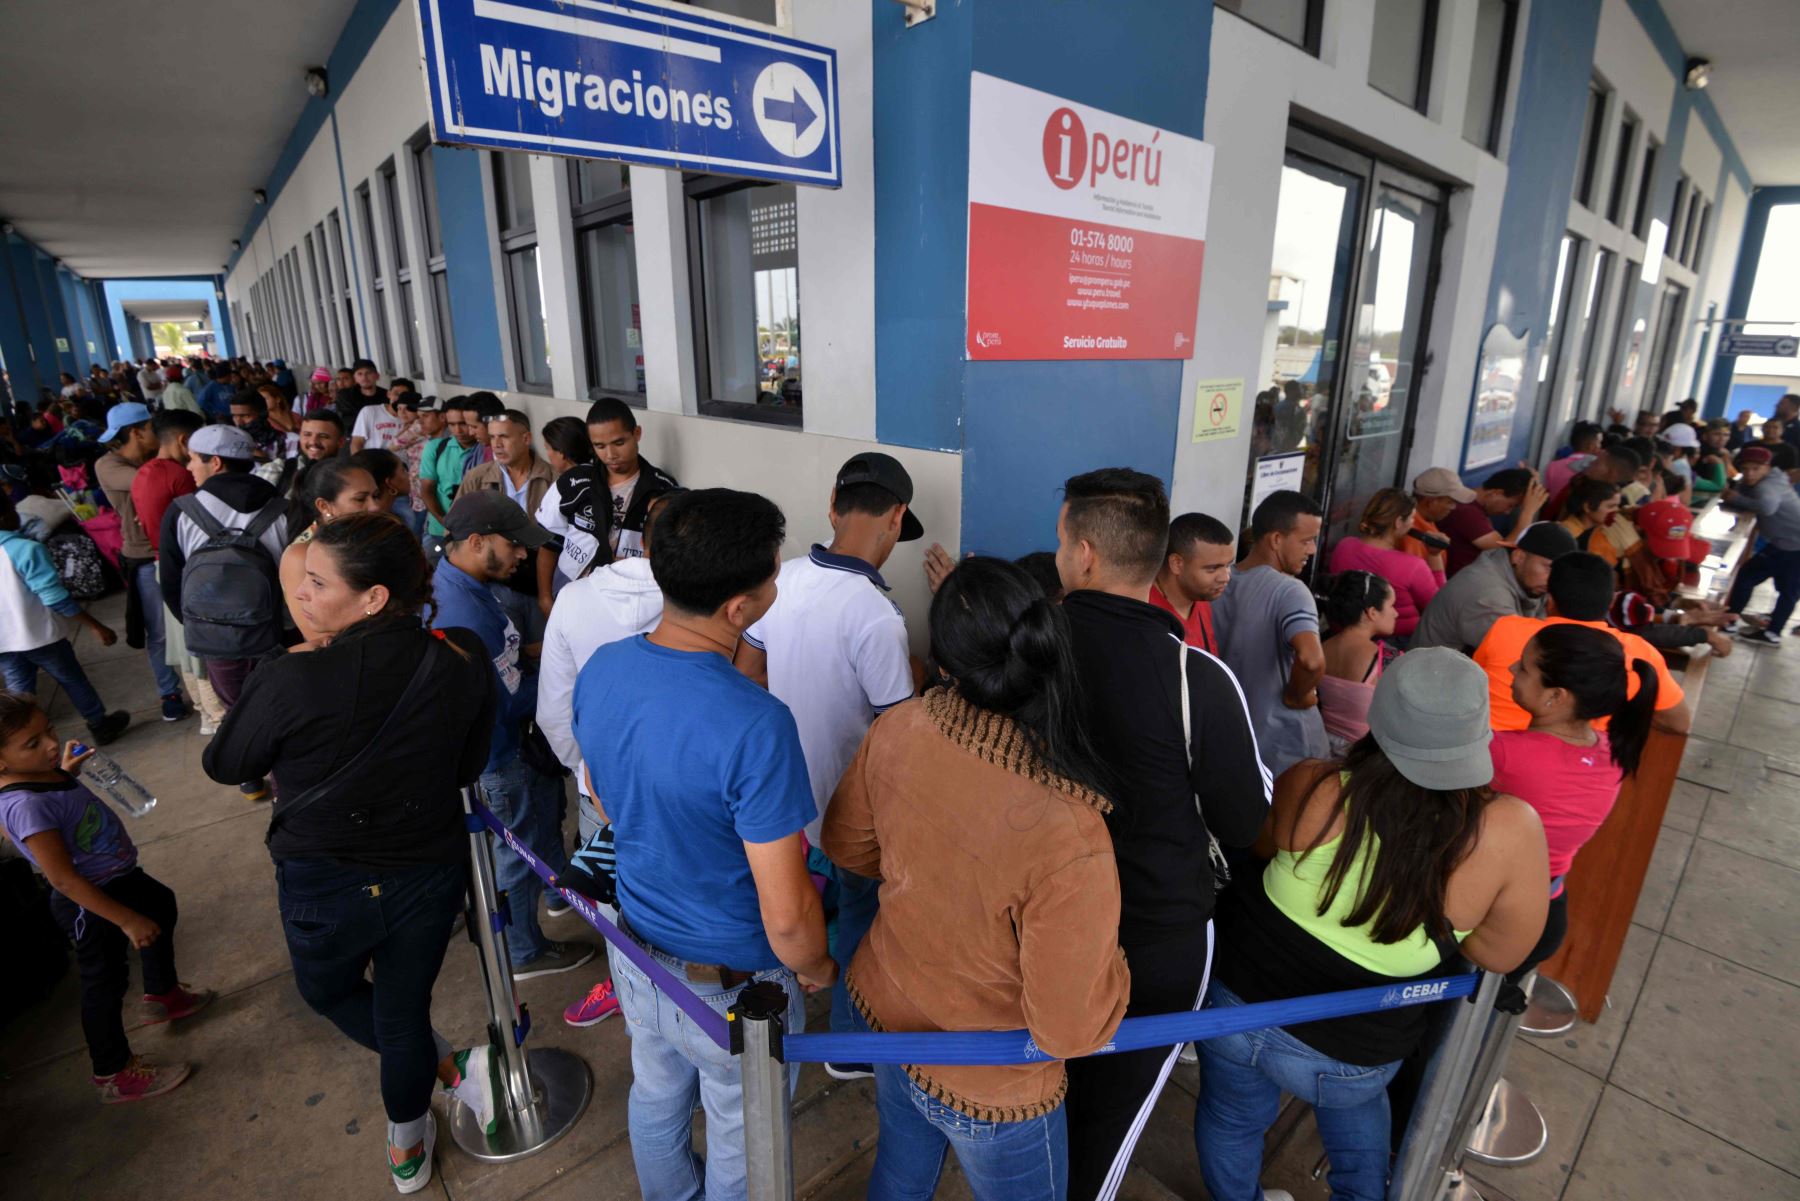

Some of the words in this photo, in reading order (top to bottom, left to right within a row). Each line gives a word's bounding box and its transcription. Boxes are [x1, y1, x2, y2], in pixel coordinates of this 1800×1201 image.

[479, 43, 733, 130] Migraciones
[1070, 227, 1105, 249] 01-574
[1107, 233, 1134, 253] 8000
[1070, 250, 1080, 263] 24
[1111, 255, 1132, 270] hours
[1063, 335, 1095, 349] Servicio
[1096, 336, 1128, 349] Gratuito
[565, 538, 588, 565] WARS
[1402, 981, 1449, 999] CEBAF
